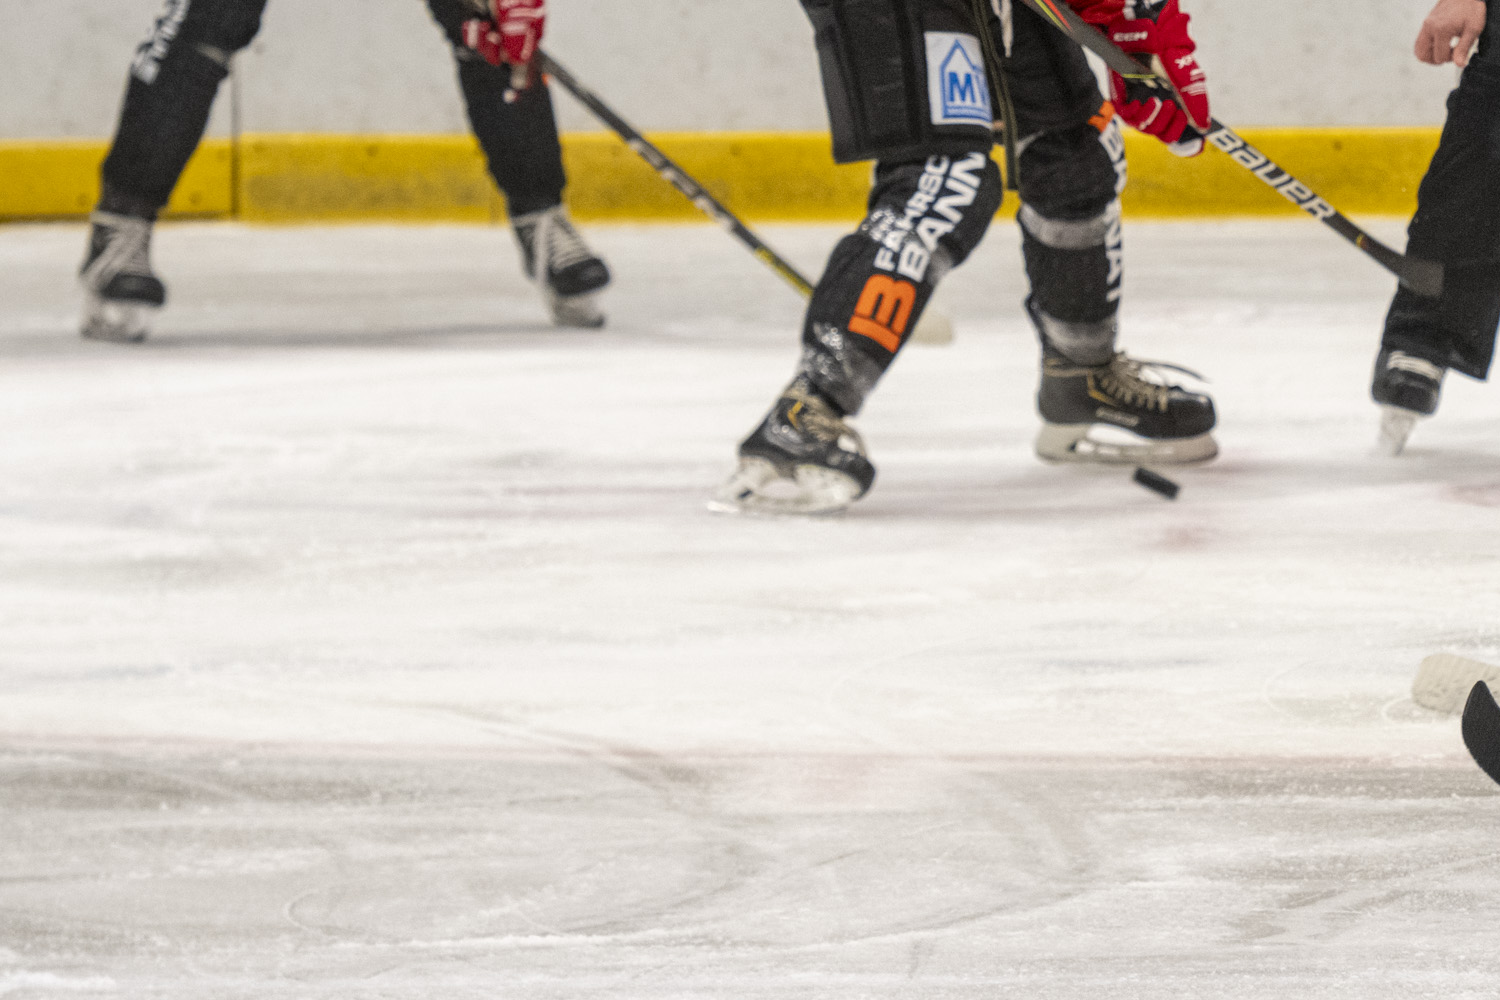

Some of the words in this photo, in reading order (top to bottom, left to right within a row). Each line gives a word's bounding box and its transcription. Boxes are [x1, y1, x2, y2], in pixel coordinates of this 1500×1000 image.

[873, 155, 949, 272] FAHRSC
[896, 151, 987, 282] BANN
[1206, 127, 1336, 222] BAUER
